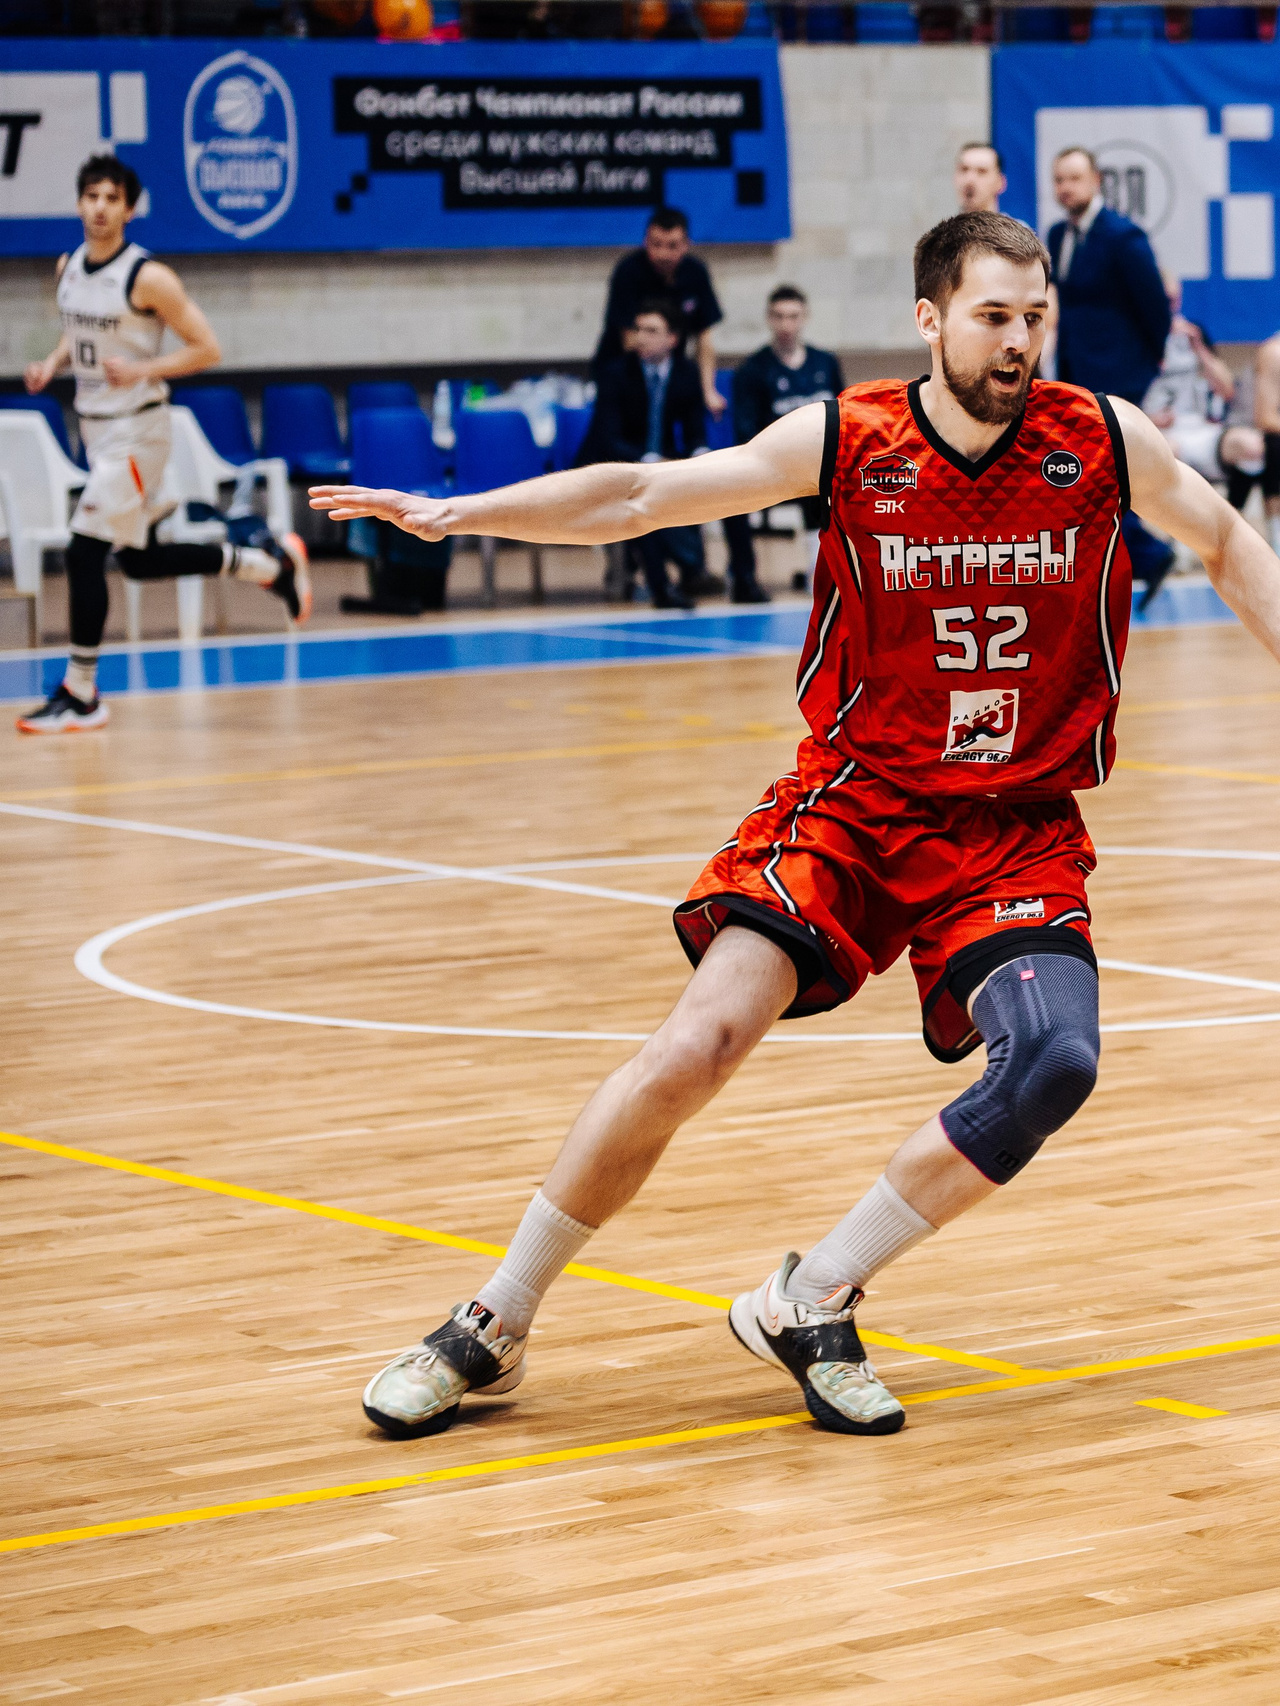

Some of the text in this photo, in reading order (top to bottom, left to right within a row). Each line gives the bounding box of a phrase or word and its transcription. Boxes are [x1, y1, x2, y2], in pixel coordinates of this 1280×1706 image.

[1047, 463, 1077, 475] РФБ
[864, 469, 916, 485] ЯСТРЕБЫ
[908, 533, 1035, 545] ЧЕБОКСАРЫ
[870, 525, 1082, 592] ЯСТРЕБЫ
[931, 605, 1031, 671] 52
[953, 699, 1000, 722] РАДИО
[942, 752, 985, 761] ENERGY
[996, 912, 1025, 922] ENERGY
